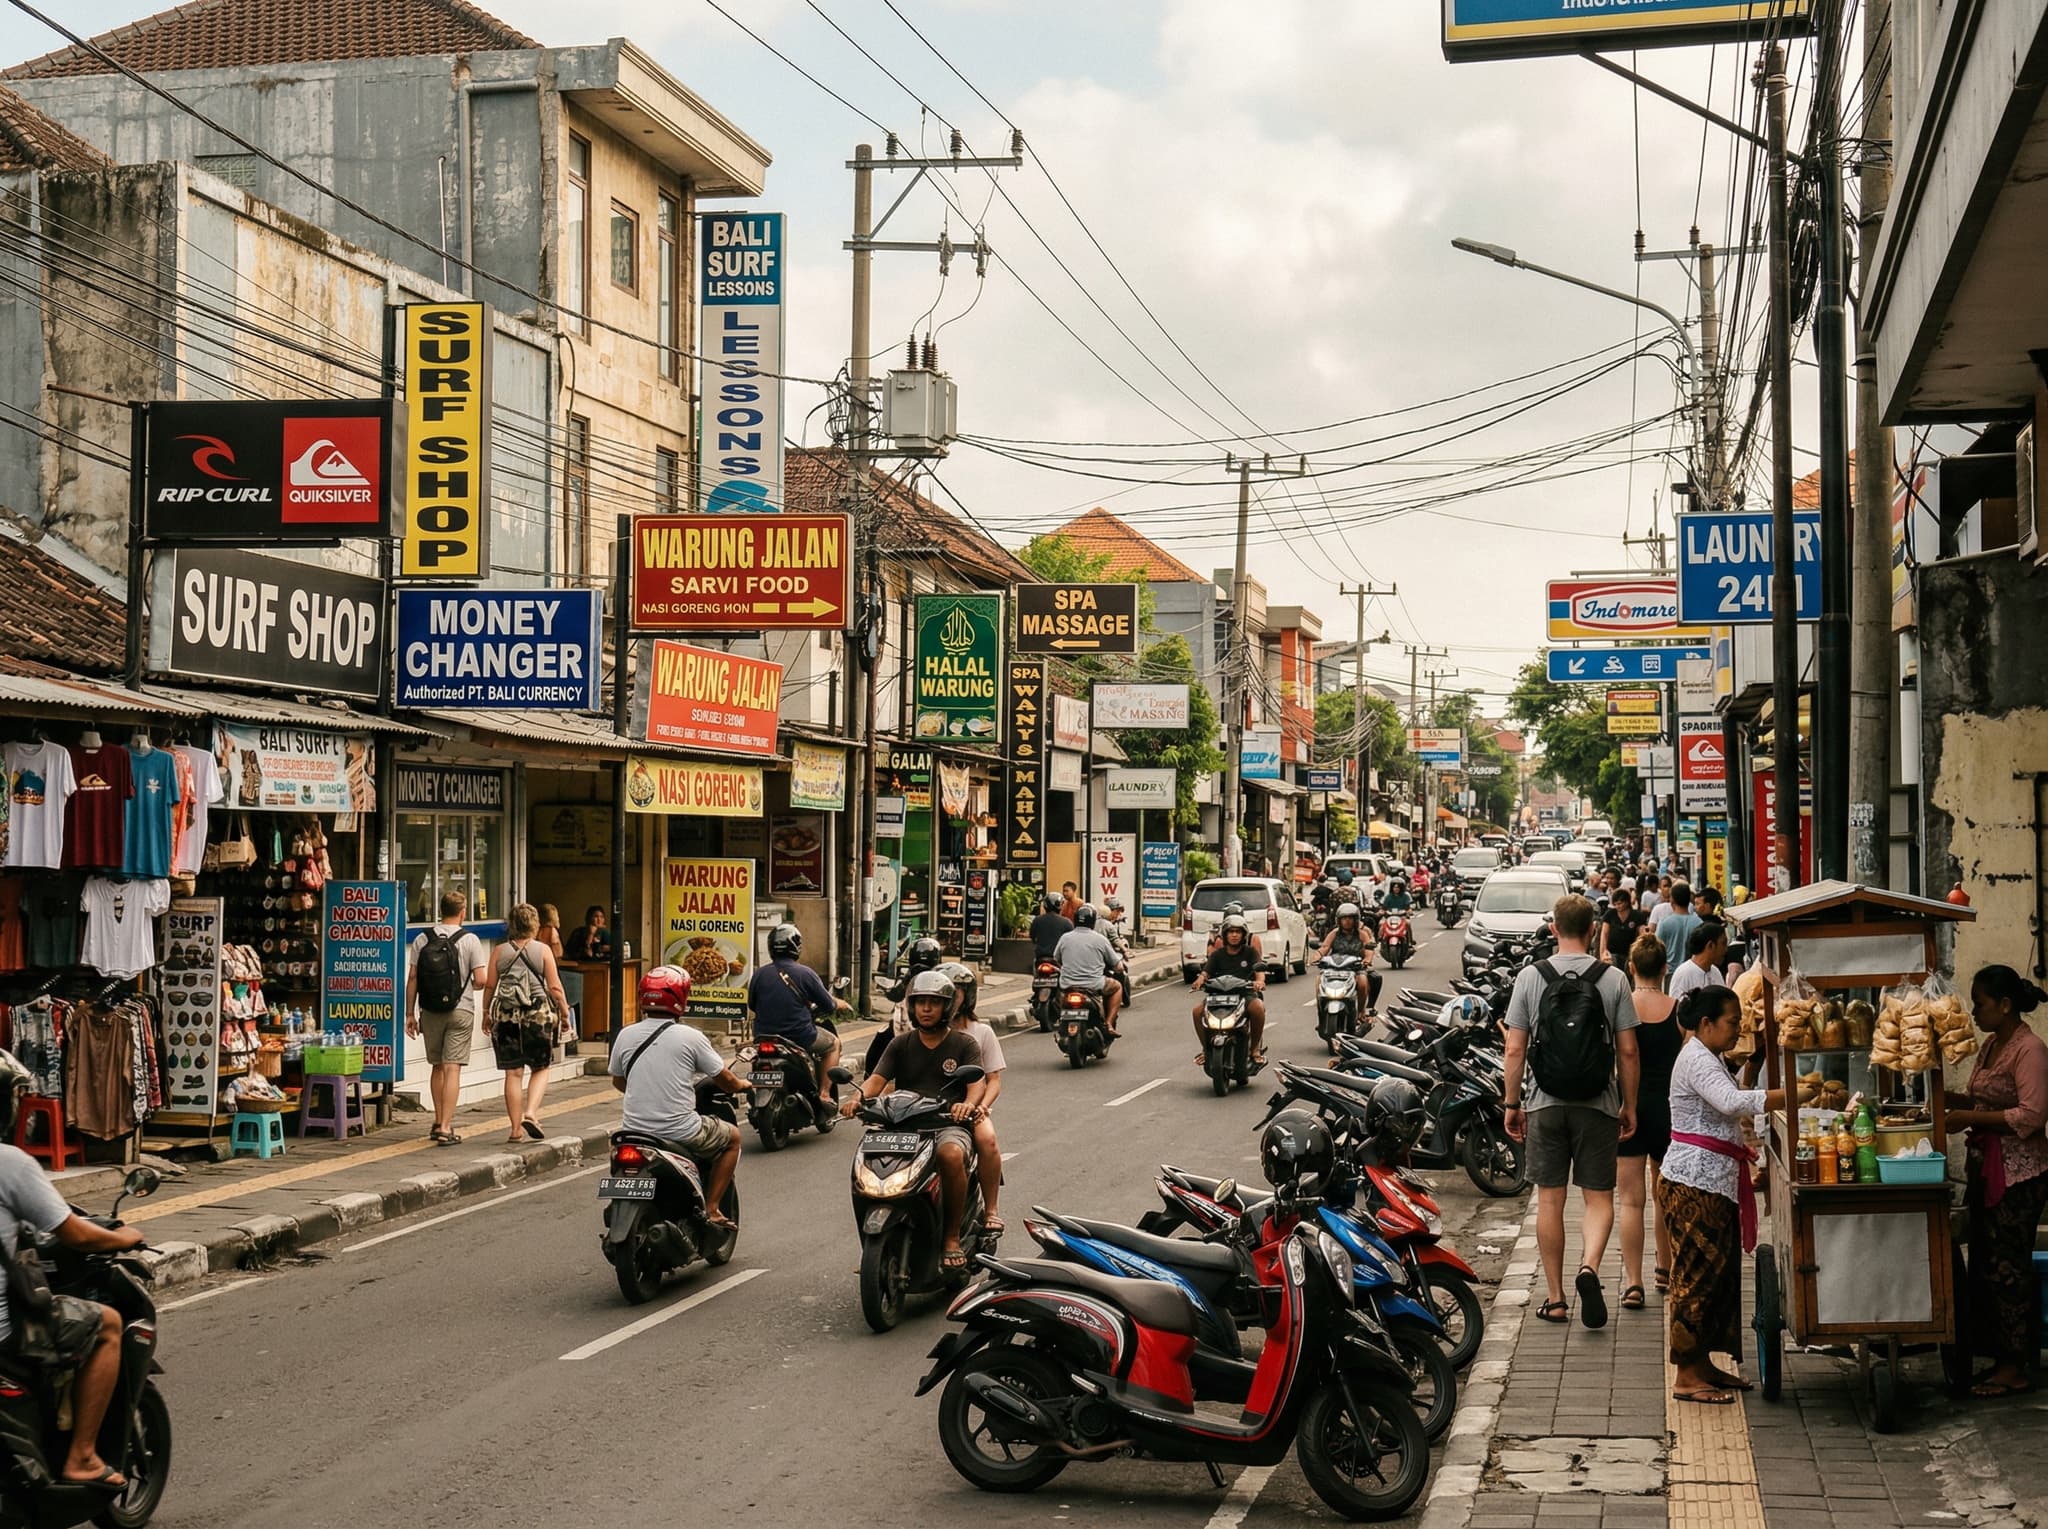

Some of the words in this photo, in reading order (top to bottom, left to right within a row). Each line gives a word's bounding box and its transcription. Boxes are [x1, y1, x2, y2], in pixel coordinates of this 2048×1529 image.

[712, 221, 771, 247] BALI
[707, 251, 775, 277] SURF
[708, 281, 775, 296] LESSONS
[417, 311, 472, 422] SURF
[717, 312, 763, 475] LESSONS
[158, 487, 204, 503] RIP
[206, 487, 272, 503] CURL
[289, 489, 371, 504] QUIKSILVER
[416, 436, 469, 568] SHOP
[642, 527, 754, 569] WARUNG
[761, 527, 839, 569] JALAN
[1687, 523, 1821, 564] LAUNR
[670, 576, 738, 594] SARVI
[746, 576, 809, 594] FOOD
[642, 603, 669, 614] NASI
[671, 603, 720, 614] GORENG
[1054, 589, 1098, 610] SPA
[181, 568, 279, 654] SURF
[288, 588, 376, 669] SHOP
[430, 599, 561, 636] MONEY
[1022, 614, 1130, 636] MASSAGE
[405, 641, 583, 679] CHANGER
[925, 656, 990, 676] HALAL
[657, 648, 730, 705] WARUNG
[732, 663, 780, 713] JALAN
[1012, 668, 1041, 679] SPA
[404, 685, 465, 700] Authorized
[468, 686, 485, 700] PT.
[488, 686, 515, 701] BALI
[518, 686, 583, 701] CURRENCY
[920, 678, 994, 698] WARUNG
[259, 728, 291, 752] BALI
[295, 732, 330, 756] SURF
[398, 771, 440, 802] MONEY
[443, 772, 501, 804] CCHANGER
[658, 768, 691, 805] NASI
[694, 770, 746, 808] GORENG
[668, 864, 748, 889] WARUNG
[343, 887, 378, 903] BALI
[678, 892, 736, 915] JALAN
[671, 919, 696, 932] NASI
[699, 920, 745, 933] GORENG
[329, 1003, 392, 1020] LAUNDRING
